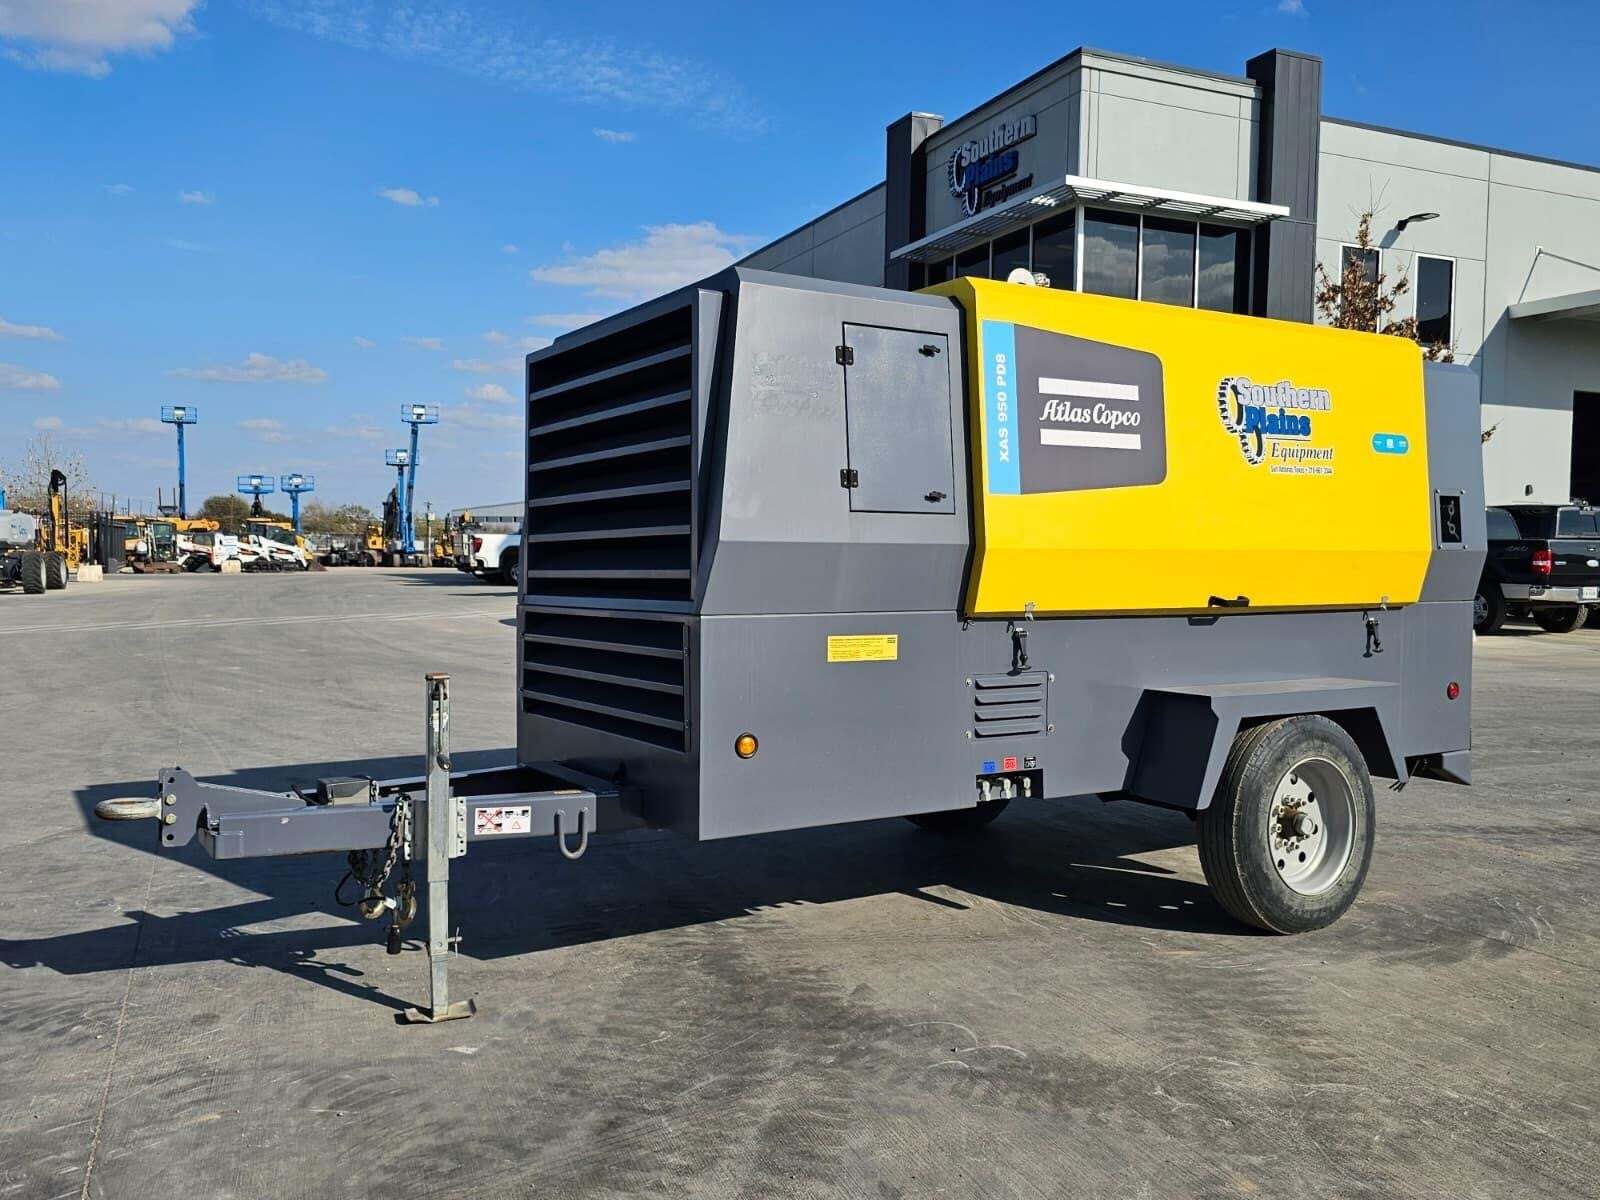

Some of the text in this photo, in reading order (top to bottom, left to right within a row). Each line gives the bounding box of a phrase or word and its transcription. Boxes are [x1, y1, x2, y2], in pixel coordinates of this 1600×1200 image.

[961, 115, 1037, 168] Southern
[997, 391, 1009, 422] 950
[1236, 377, 1331, 410] Southern
[1039, 399, 1141, 430] Atlas Copco
[1245, 405, 1311, 436] Plains
[998, 427, 1010, 463] XAS
[1271, 442, 1334, 463] Equipment
